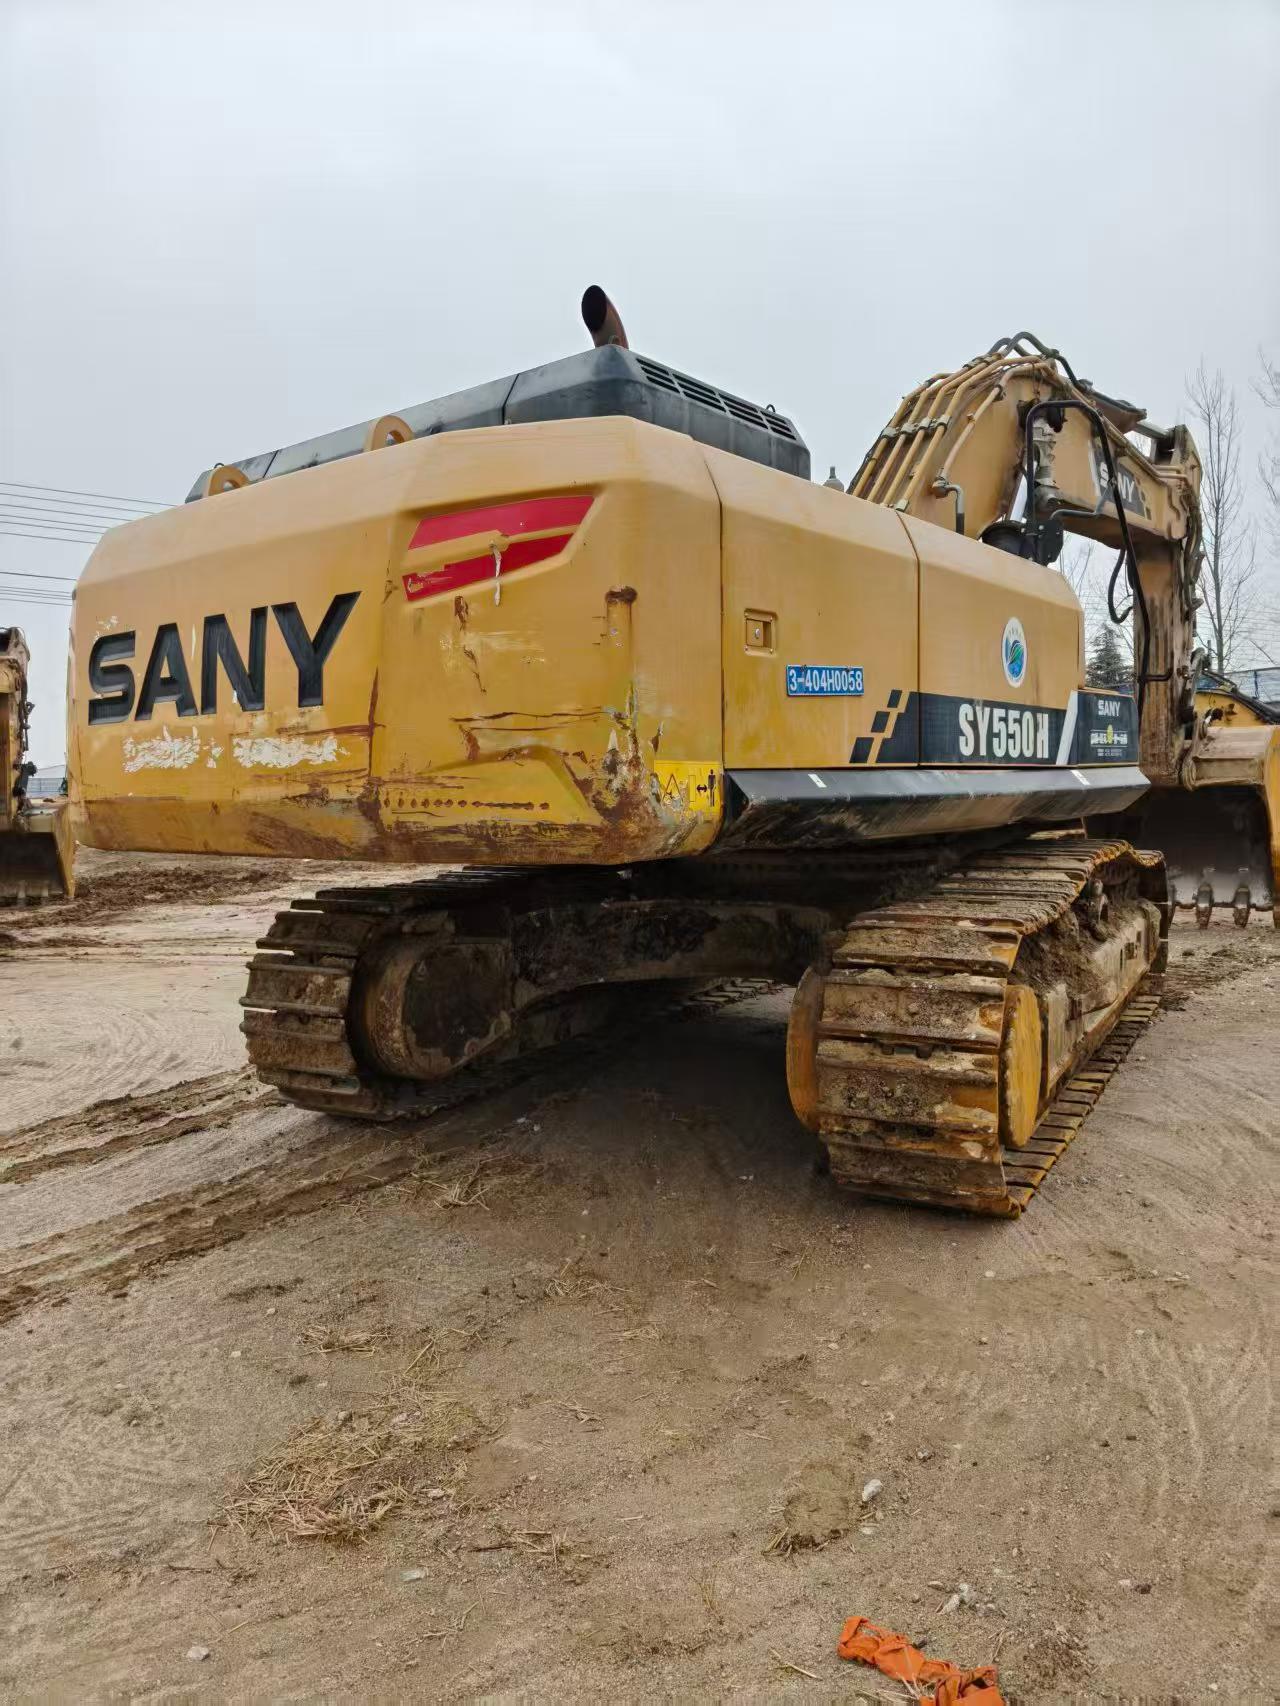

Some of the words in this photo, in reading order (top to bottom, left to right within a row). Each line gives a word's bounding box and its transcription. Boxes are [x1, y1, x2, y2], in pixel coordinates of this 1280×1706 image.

[1100, 461, 1135, 502] SNY
[88, 590, 362, 725] SANY
[789, 669, 863, 691] 3-404H0058
[1098, 699, 1120, 716] SANY
[959, 703, 1049, 759] SY550H
